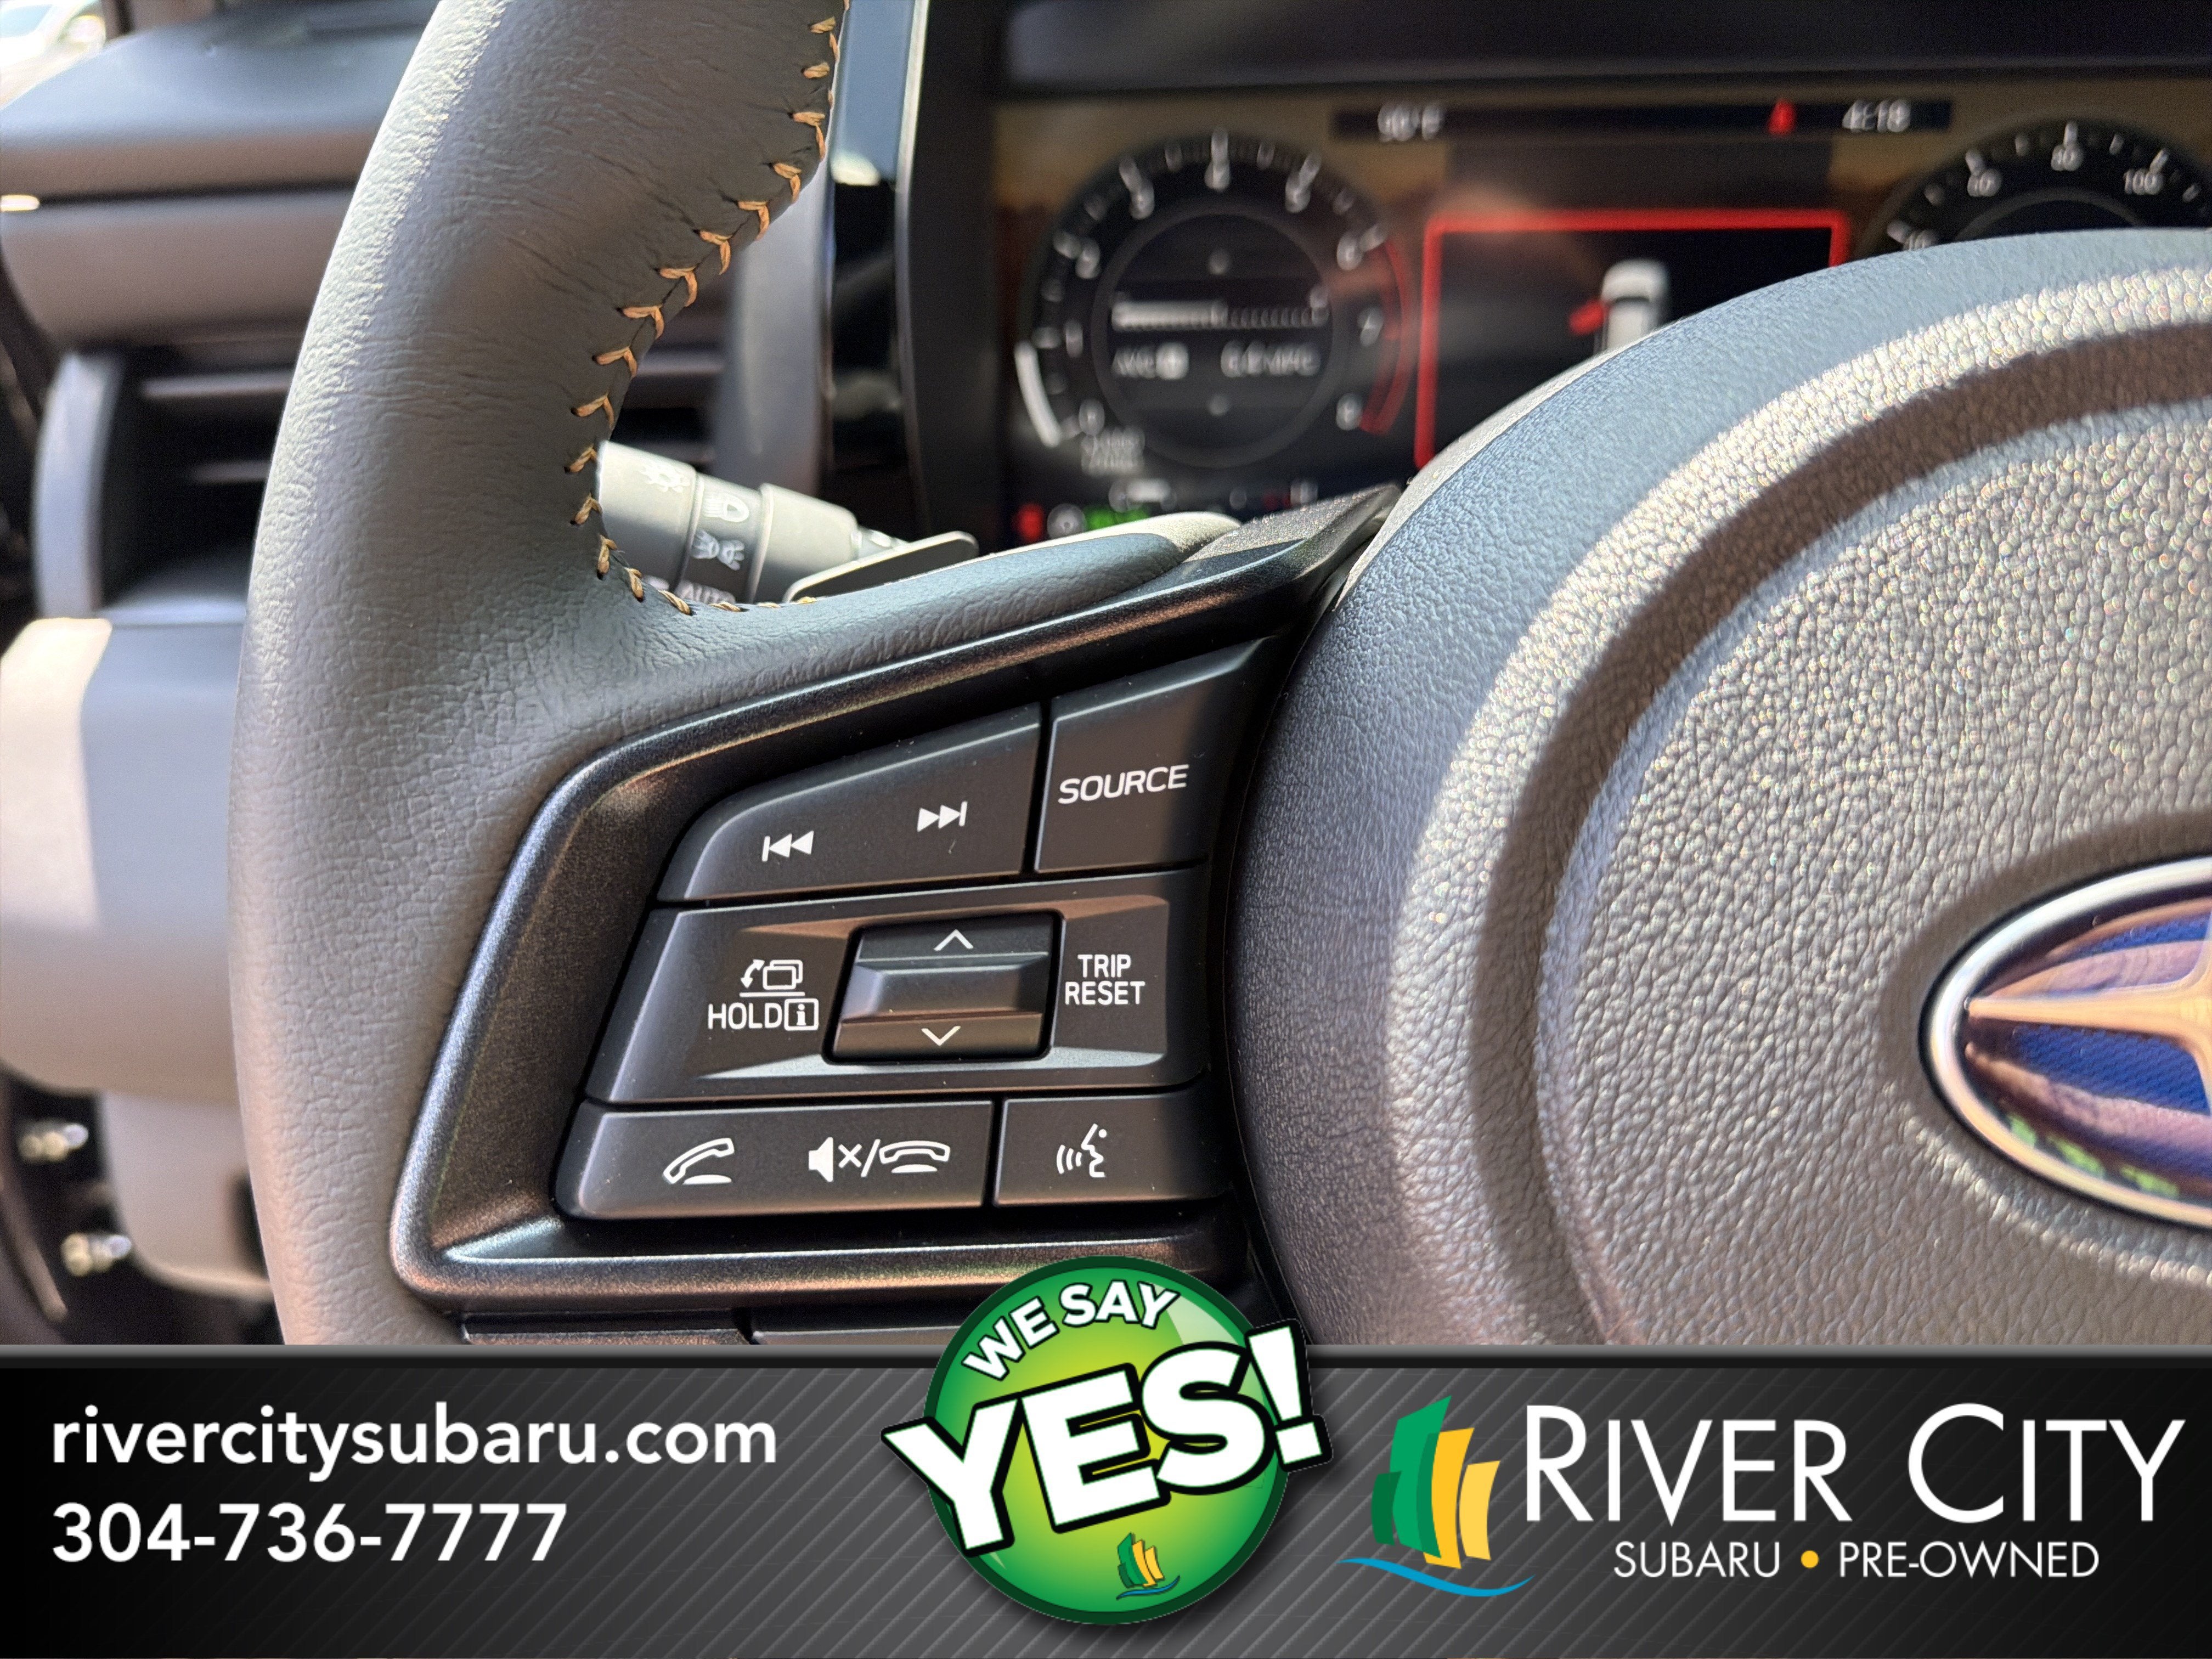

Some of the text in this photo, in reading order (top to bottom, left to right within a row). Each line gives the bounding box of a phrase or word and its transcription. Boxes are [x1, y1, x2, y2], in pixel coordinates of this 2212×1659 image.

[1058, 764, 1189, 805] SOURCE
[1077, 954, 1131, 978] TRIP
[1065, 980, 1146, 1006] RESET
[708, 1002, 783, 1030] HOLD
